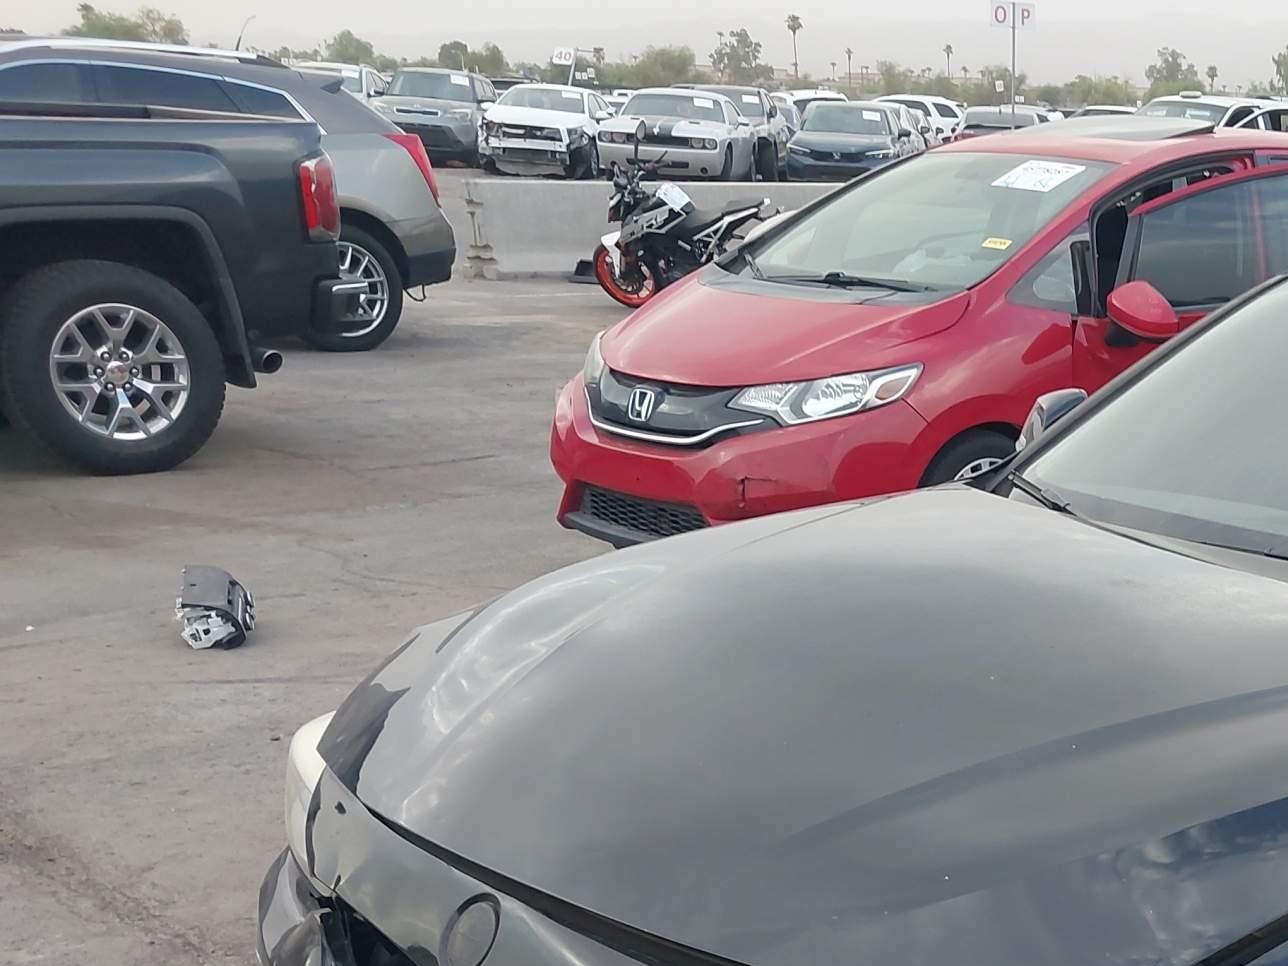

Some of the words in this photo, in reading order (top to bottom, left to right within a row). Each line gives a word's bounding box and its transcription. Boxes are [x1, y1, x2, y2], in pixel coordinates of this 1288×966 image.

[994, 5, 1007, 24] O
[1021, 8, 1031, 26] P
[555, 51, 572, 62] 40
